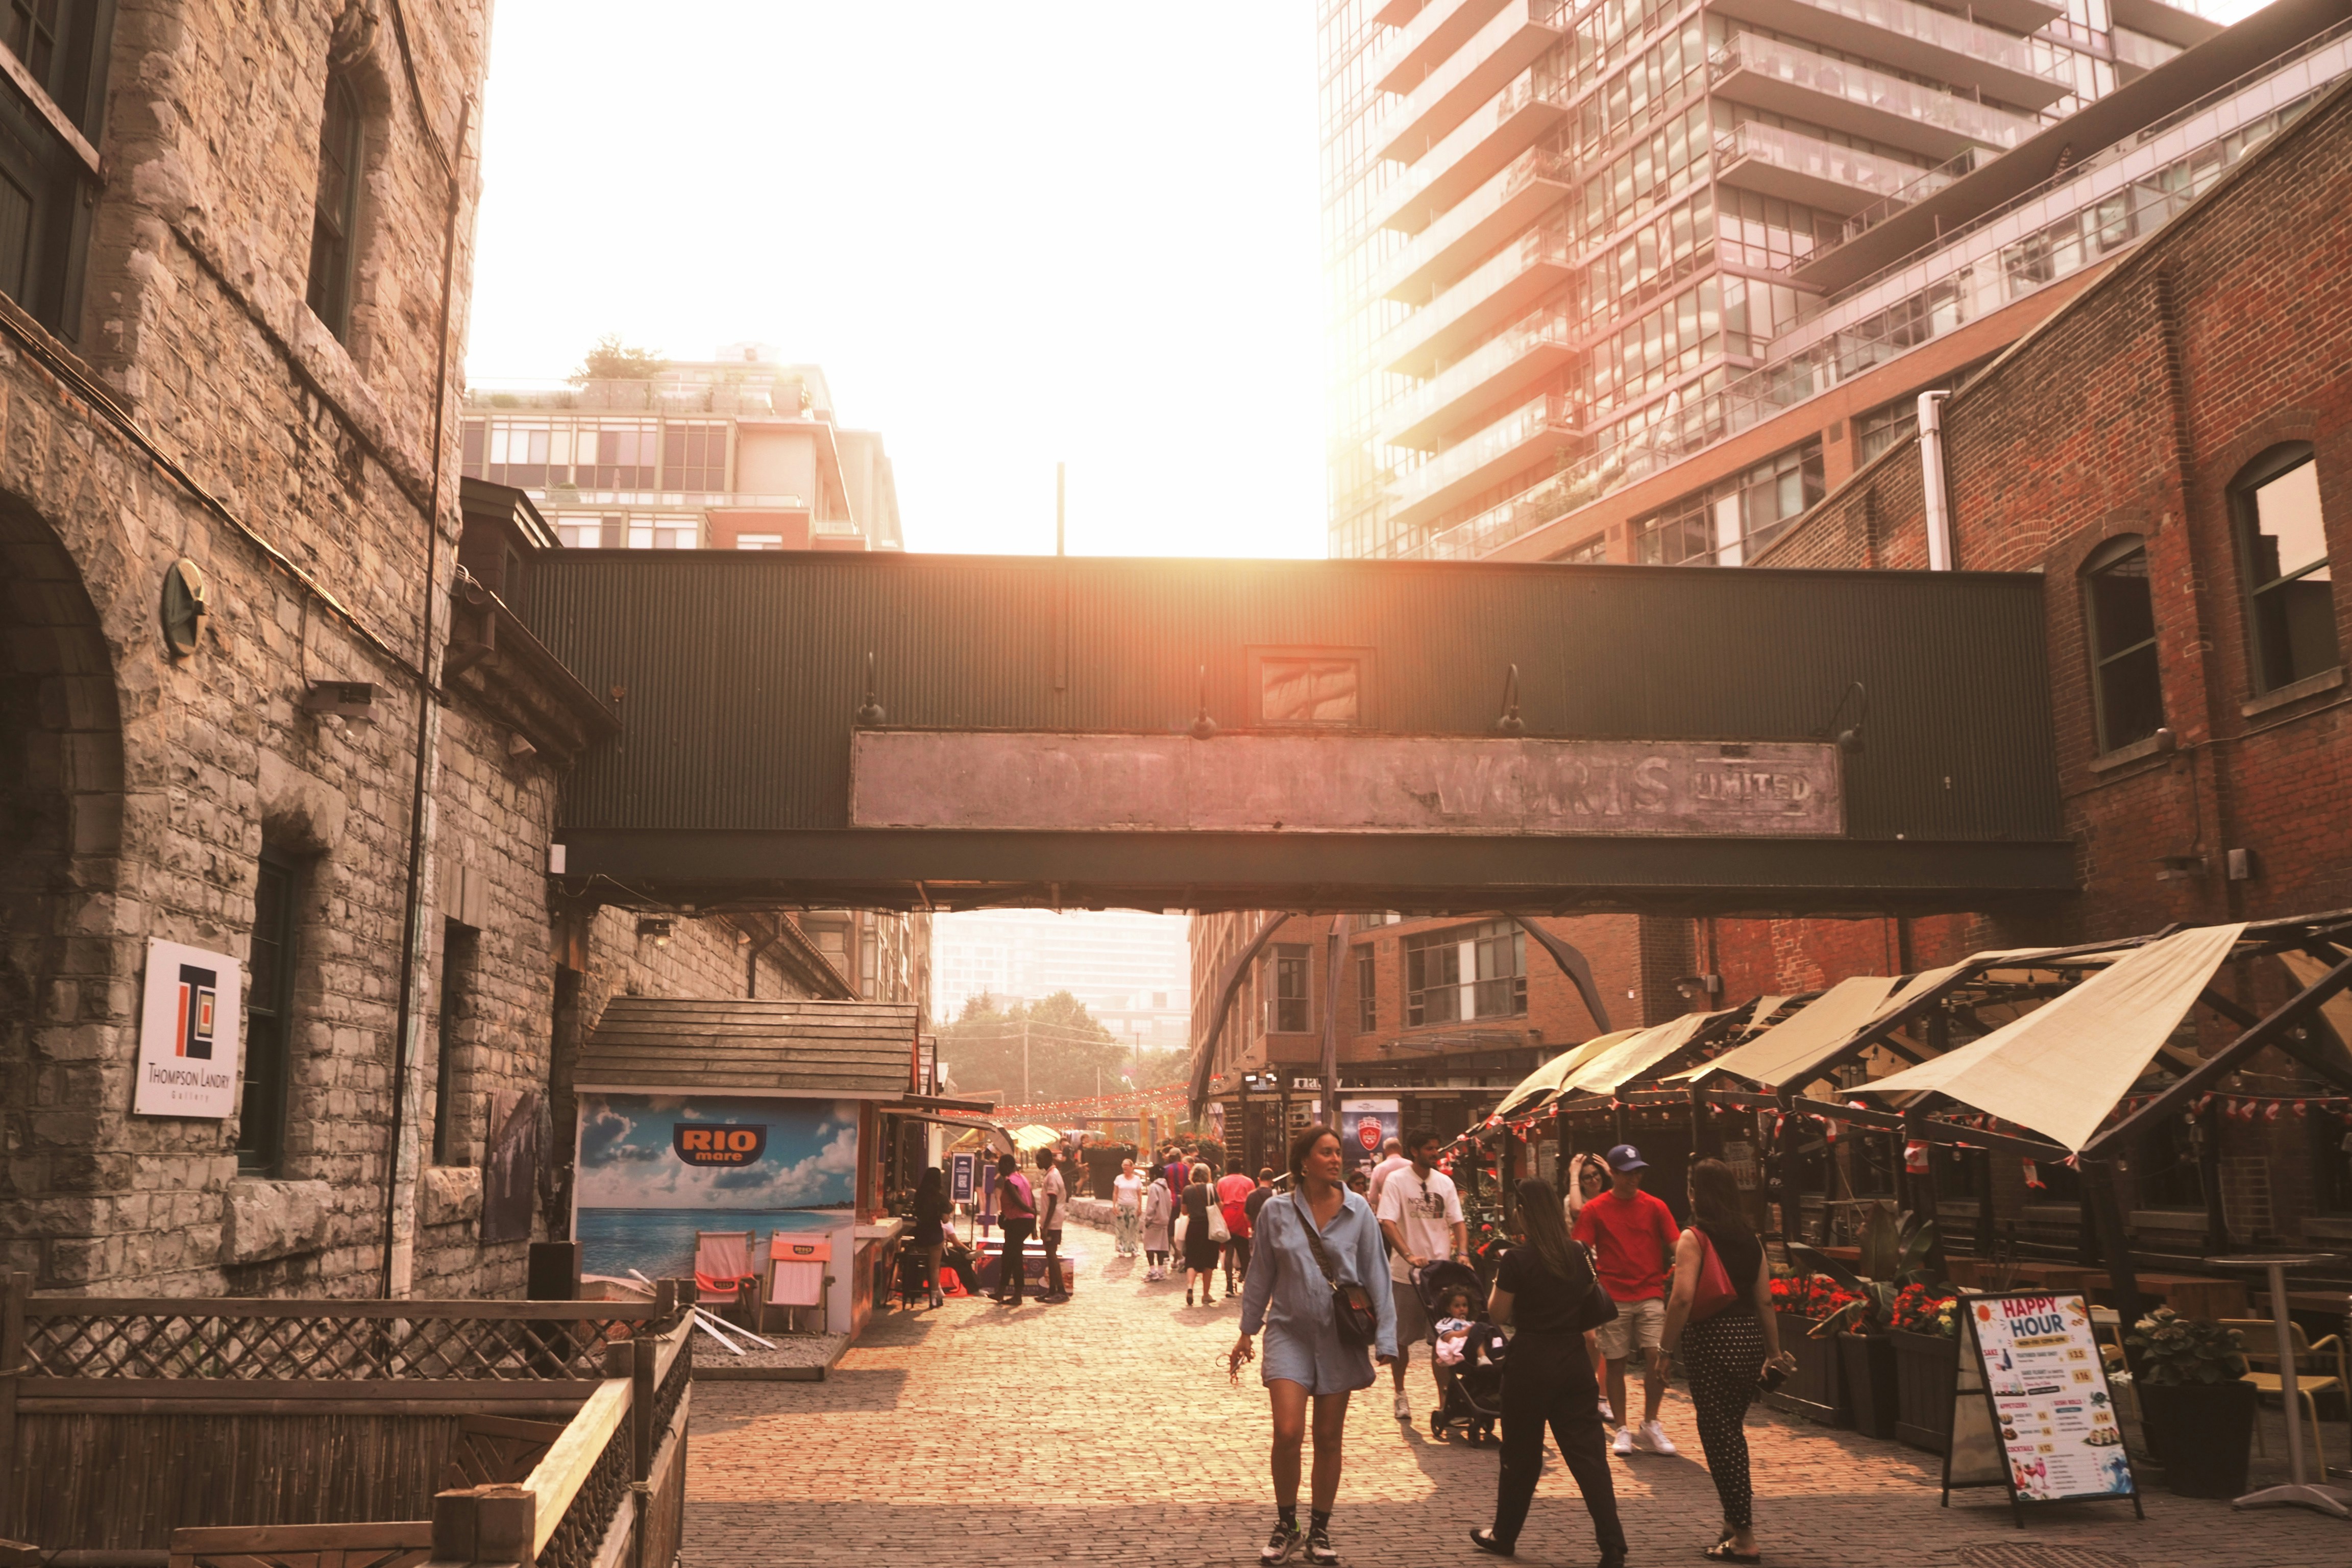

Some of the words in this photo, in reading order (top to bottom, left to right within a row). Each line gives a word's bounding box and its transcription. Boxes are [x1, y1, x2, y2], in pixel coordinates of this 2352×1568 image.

[1695, 772, 1811, 801] LIMITED
[148, 1062, 198, 1087] THOMPSON
[201, 1068, 230, 1089] LANDRY
[682, 1130, 757, 1152] RIO
[695, 1152, 743, 1162] mare
[2001, 1297, 2056, 1318] HAPPY
[2010, 1314, 2066, 1337] HOUR
